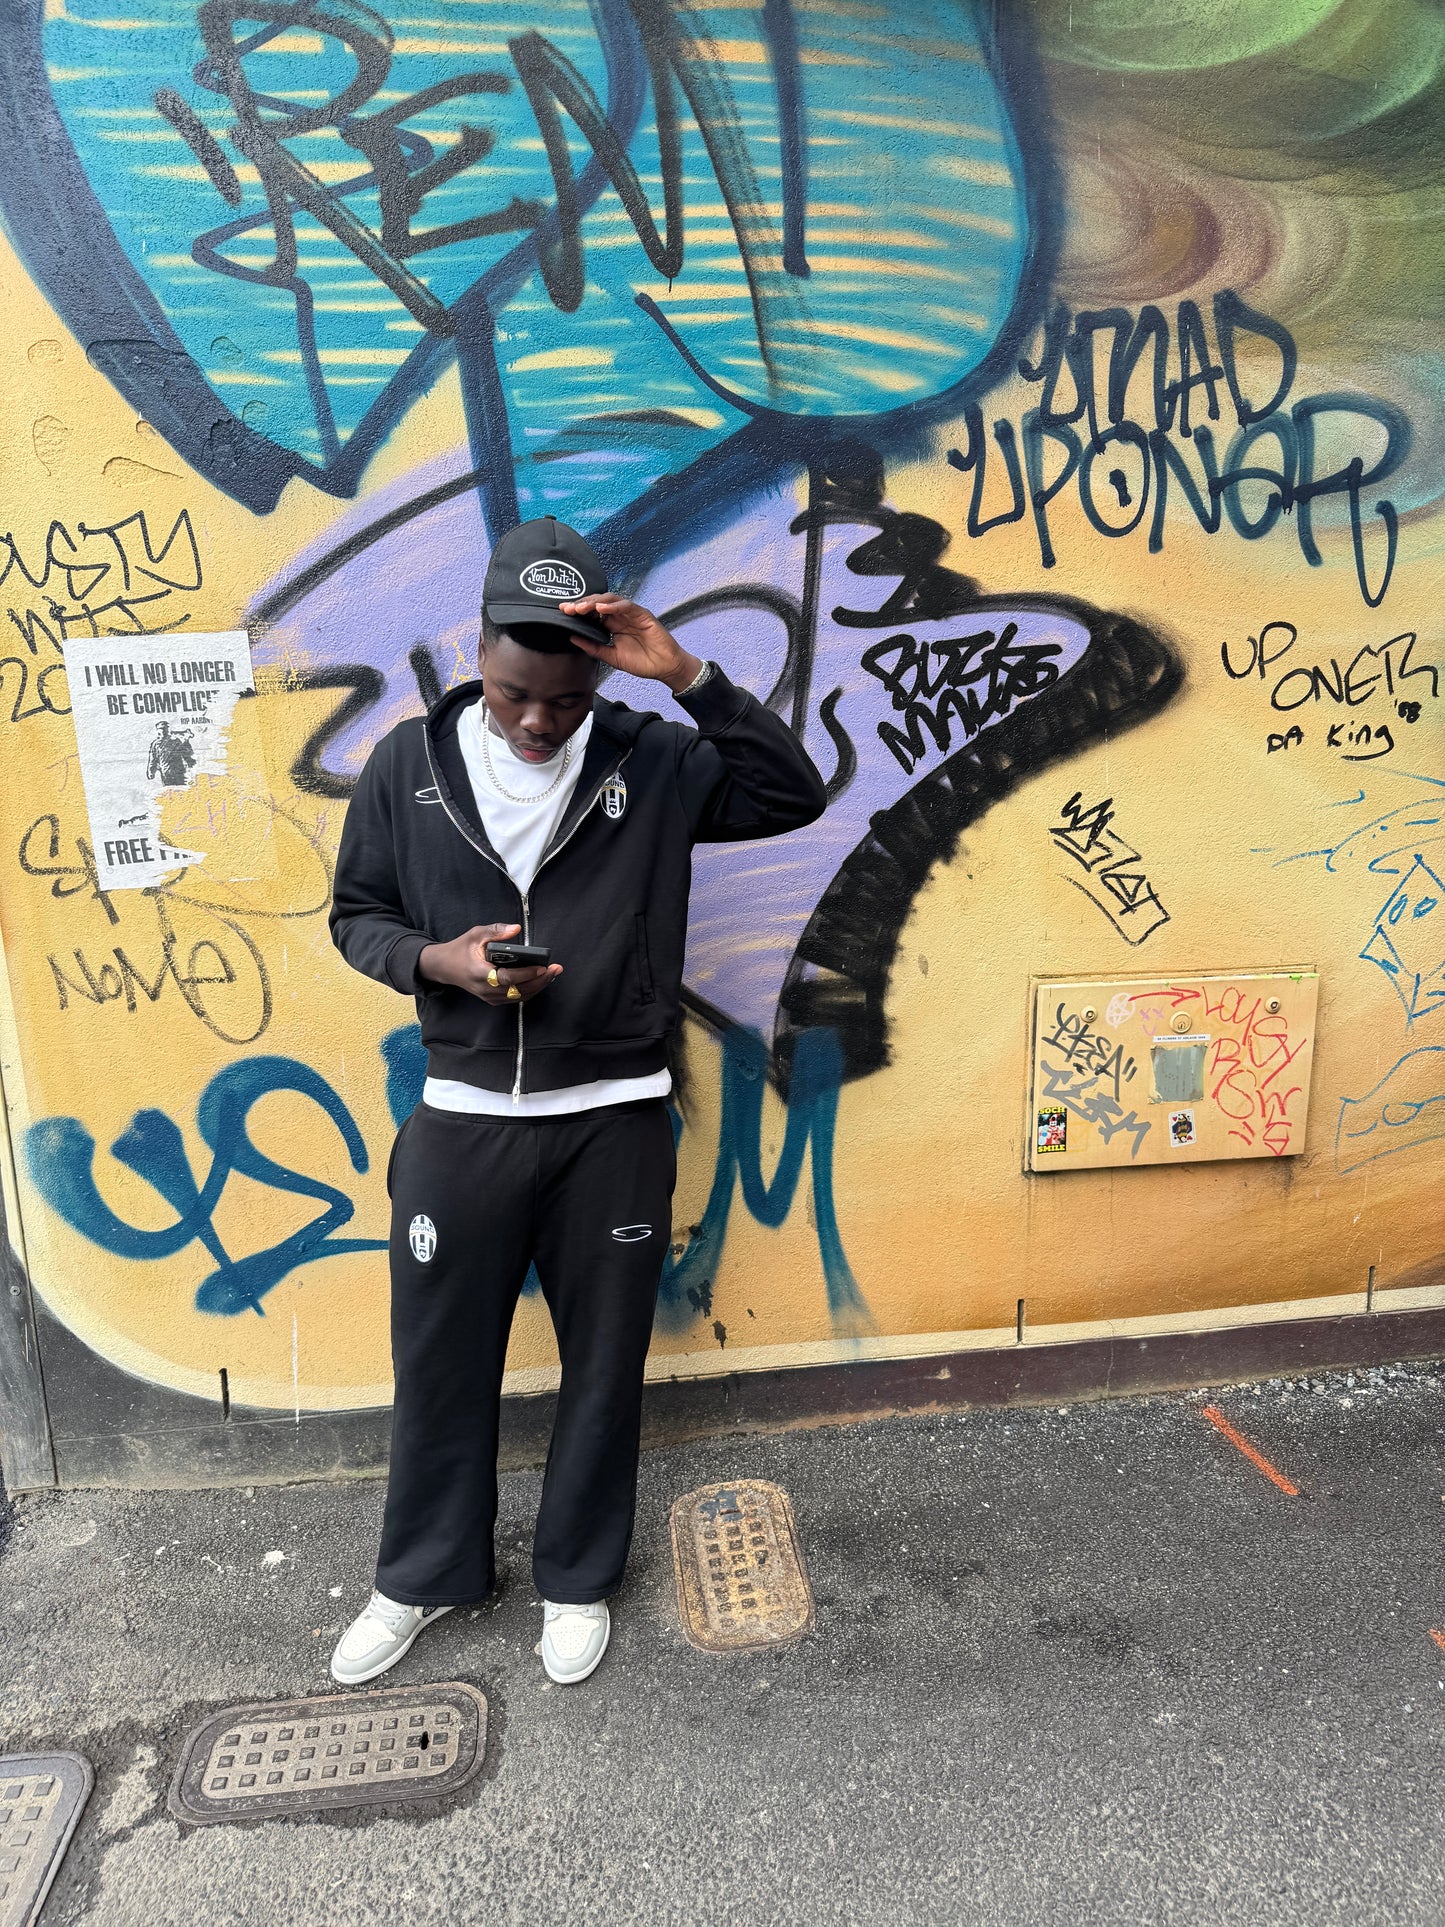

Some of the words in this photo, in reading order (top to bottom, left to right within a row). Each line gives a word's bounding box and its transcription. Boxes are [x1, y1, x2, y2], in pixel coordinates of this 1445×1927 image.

[548, 567, 578, 590] Dutch
[536, 587, 569, 596] CALIFORNIA
[1221, 621, 1297, 680] UP
[84, 665, 92, 687] I
[95, 664, 139, 686] WILL
[142, 662, 167, 685] NO
[171, 660, 236, 684] LONGER
[106, 694, 129, 715] BE
[104, 838, 154, 866] FREE
